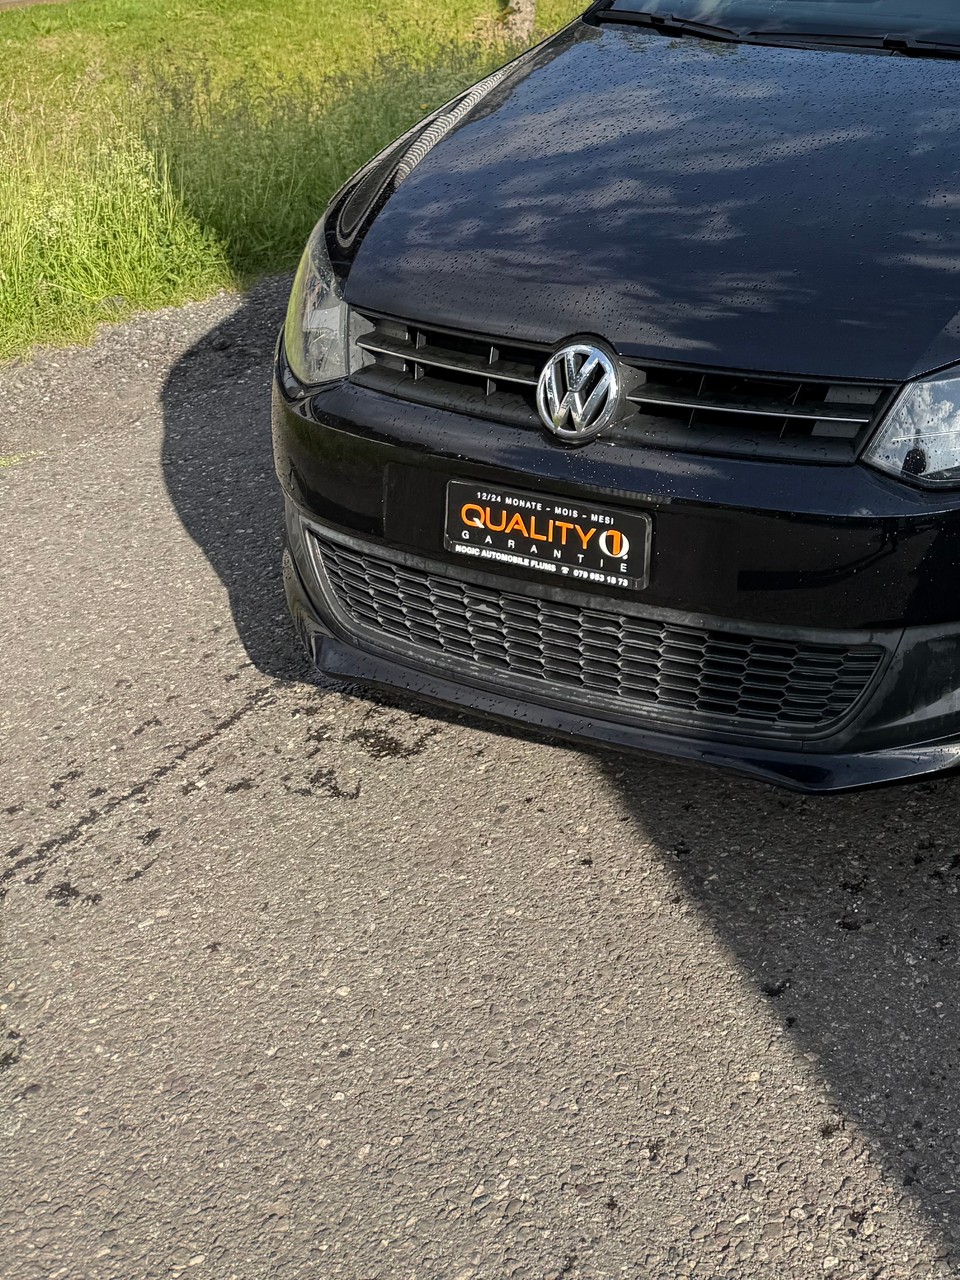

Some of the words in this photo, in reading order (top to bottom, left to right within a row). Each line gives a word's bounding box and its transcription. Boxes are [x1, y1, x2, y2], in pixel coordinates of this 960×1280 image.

[540, 347, 615, 436] VW
[477, 492, 502, 503] 12/24
[505, 497, 542, 511] MONATE
[554, 506, 578, 518] MOIS
[591, 514, 614, 525] MESI
[462, 531, 628, 573] GARANTIE
[481, 549, 529, 566] AUTOMOBILE
[530, 560, 556, 571] FLUMS
